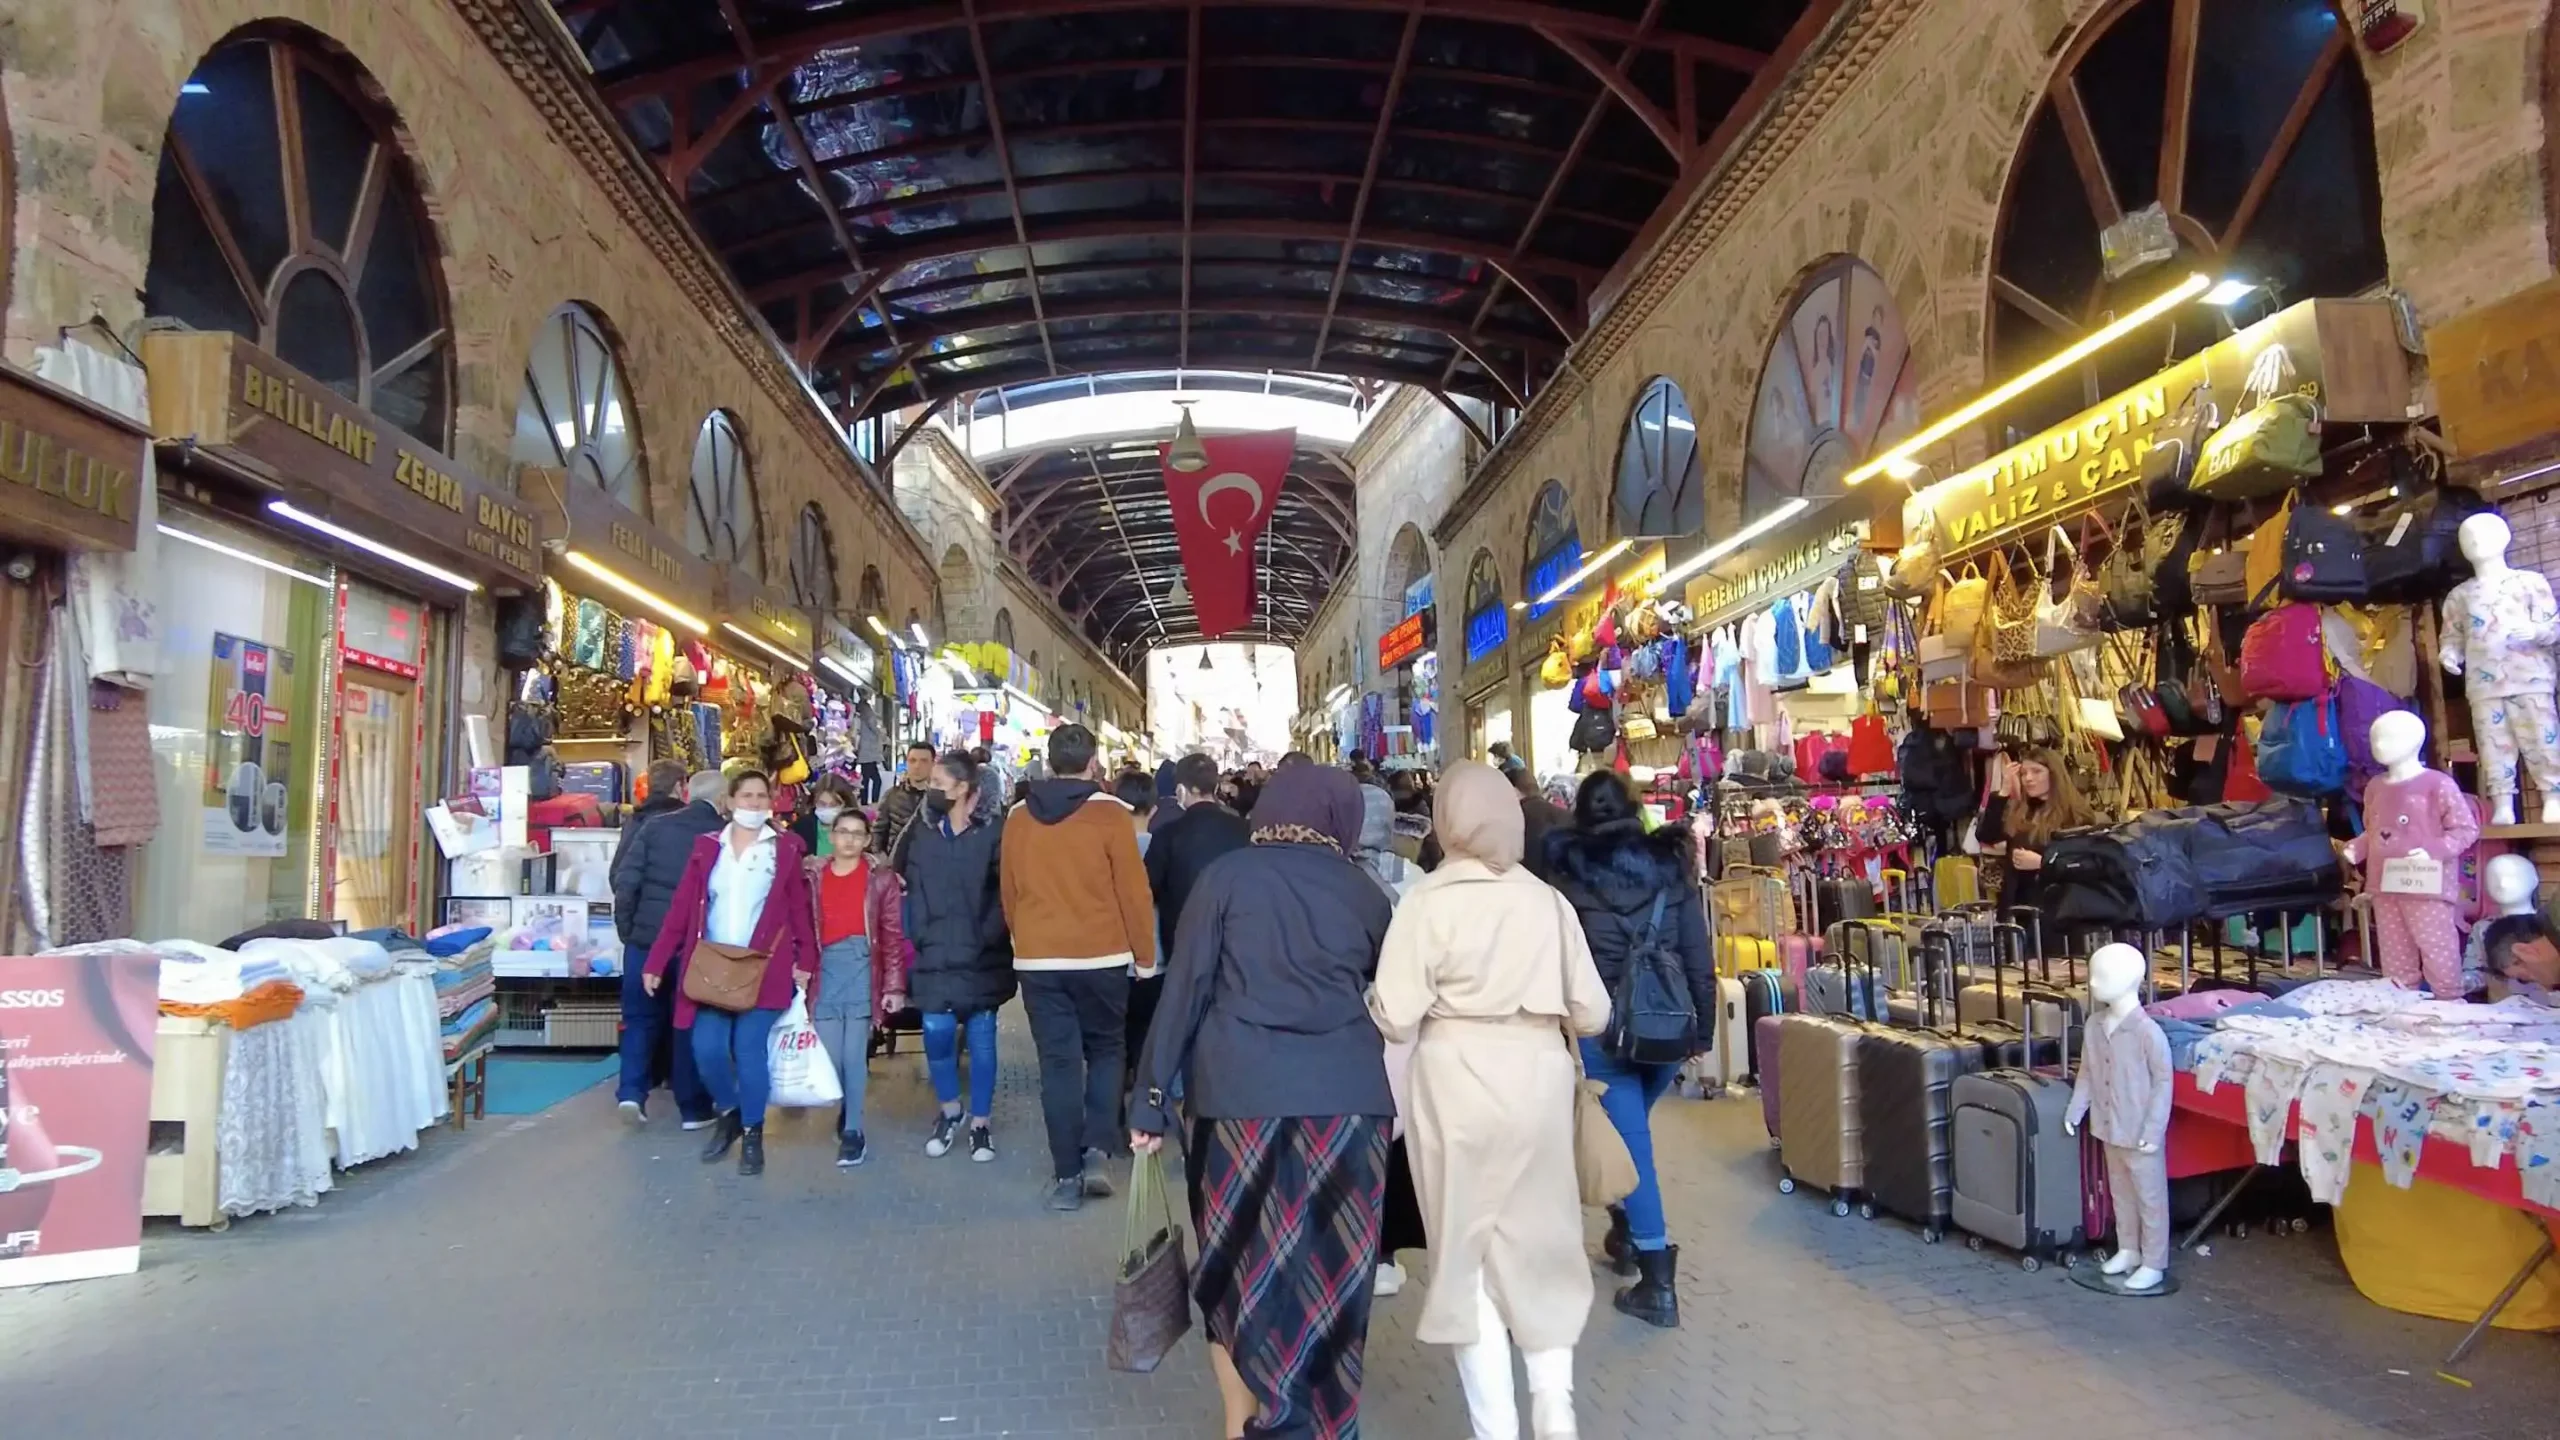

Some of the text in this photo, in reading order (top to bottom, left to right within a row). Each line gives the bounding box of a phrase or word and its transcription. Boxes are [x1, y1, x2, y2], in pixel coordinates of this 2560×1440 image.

[244, 363, 533, 550] BRİLLANT ZEBRA BAYİSİ
[1950, 485, 2041, 543] VALİZ
[2053, 481, 2069, 502] &
[1698, 568, 1758, 617] BEBERİUM
[1759, 544, 1808, 596] ÇOCUK
[224, 689, 265, 738] 40
